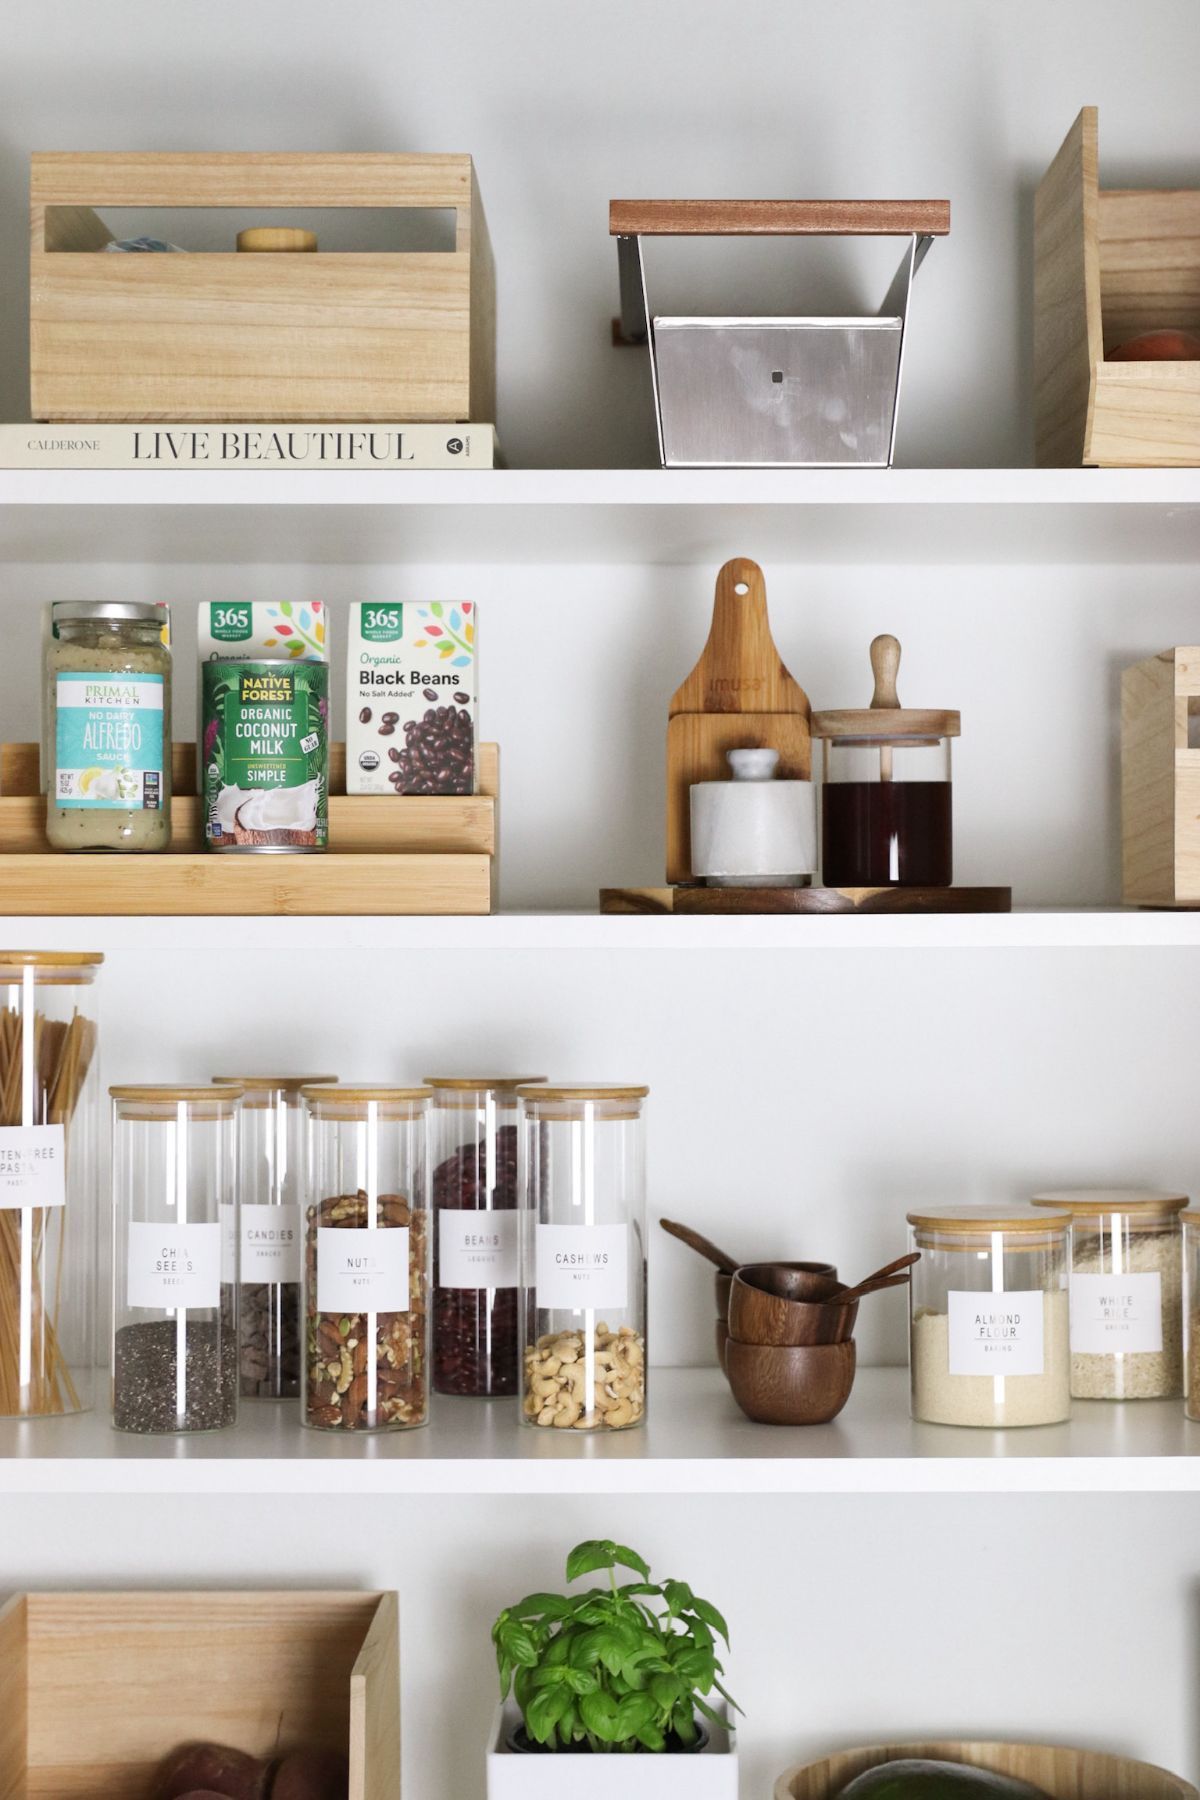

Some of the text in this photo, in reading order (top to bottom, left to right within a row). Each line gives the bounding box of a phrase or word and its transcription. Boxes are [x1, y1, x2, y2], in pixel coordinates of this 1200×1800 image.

[27, 439, 101, 451] CALDERONE
[131, 432, 415, 460] LIVE BEAUTIFUL
[214, 608, 249, 628] 365
[364, 608, 399, 629] 365
[360, 652, 402, 667] Organic
[243, 677, 291, 689] NATIVE
[359, 670, 460, 685] Black Beans
[85, 685, 140, 698] PRIMAL
[242, 690, 292, 701] FOREST
[84, 697, 140, 705] KITCHEN
[89, 711, 135, 721] NO DAIRY
[240, 708, 293, 720] ORGANIC
[83, 721, 142, 751] ALFREDO
[235, 723, 298, 738] COCONUT
[250, 740, 284, 755] MILK
[247, 770, 287, 782] SIMPLE
[0, 1162, 34, 1173] PASA
[247, 1230, 294, 1240] CANDIES
[465, 1235, 500, 1246] BEANS
[161, 1247, 190, 1258] CHA
[347, 1257, 376, 1268] NUT
[555, 1253, 609, 1264] CASHWS
[156, 1260, 194, 1271] SEES
[1103, 1307, 1129, 1318] RIE
[975, 1314, 1021, 1325] ALMOND
[980, 1327, 1017, 1338] FLOUR
